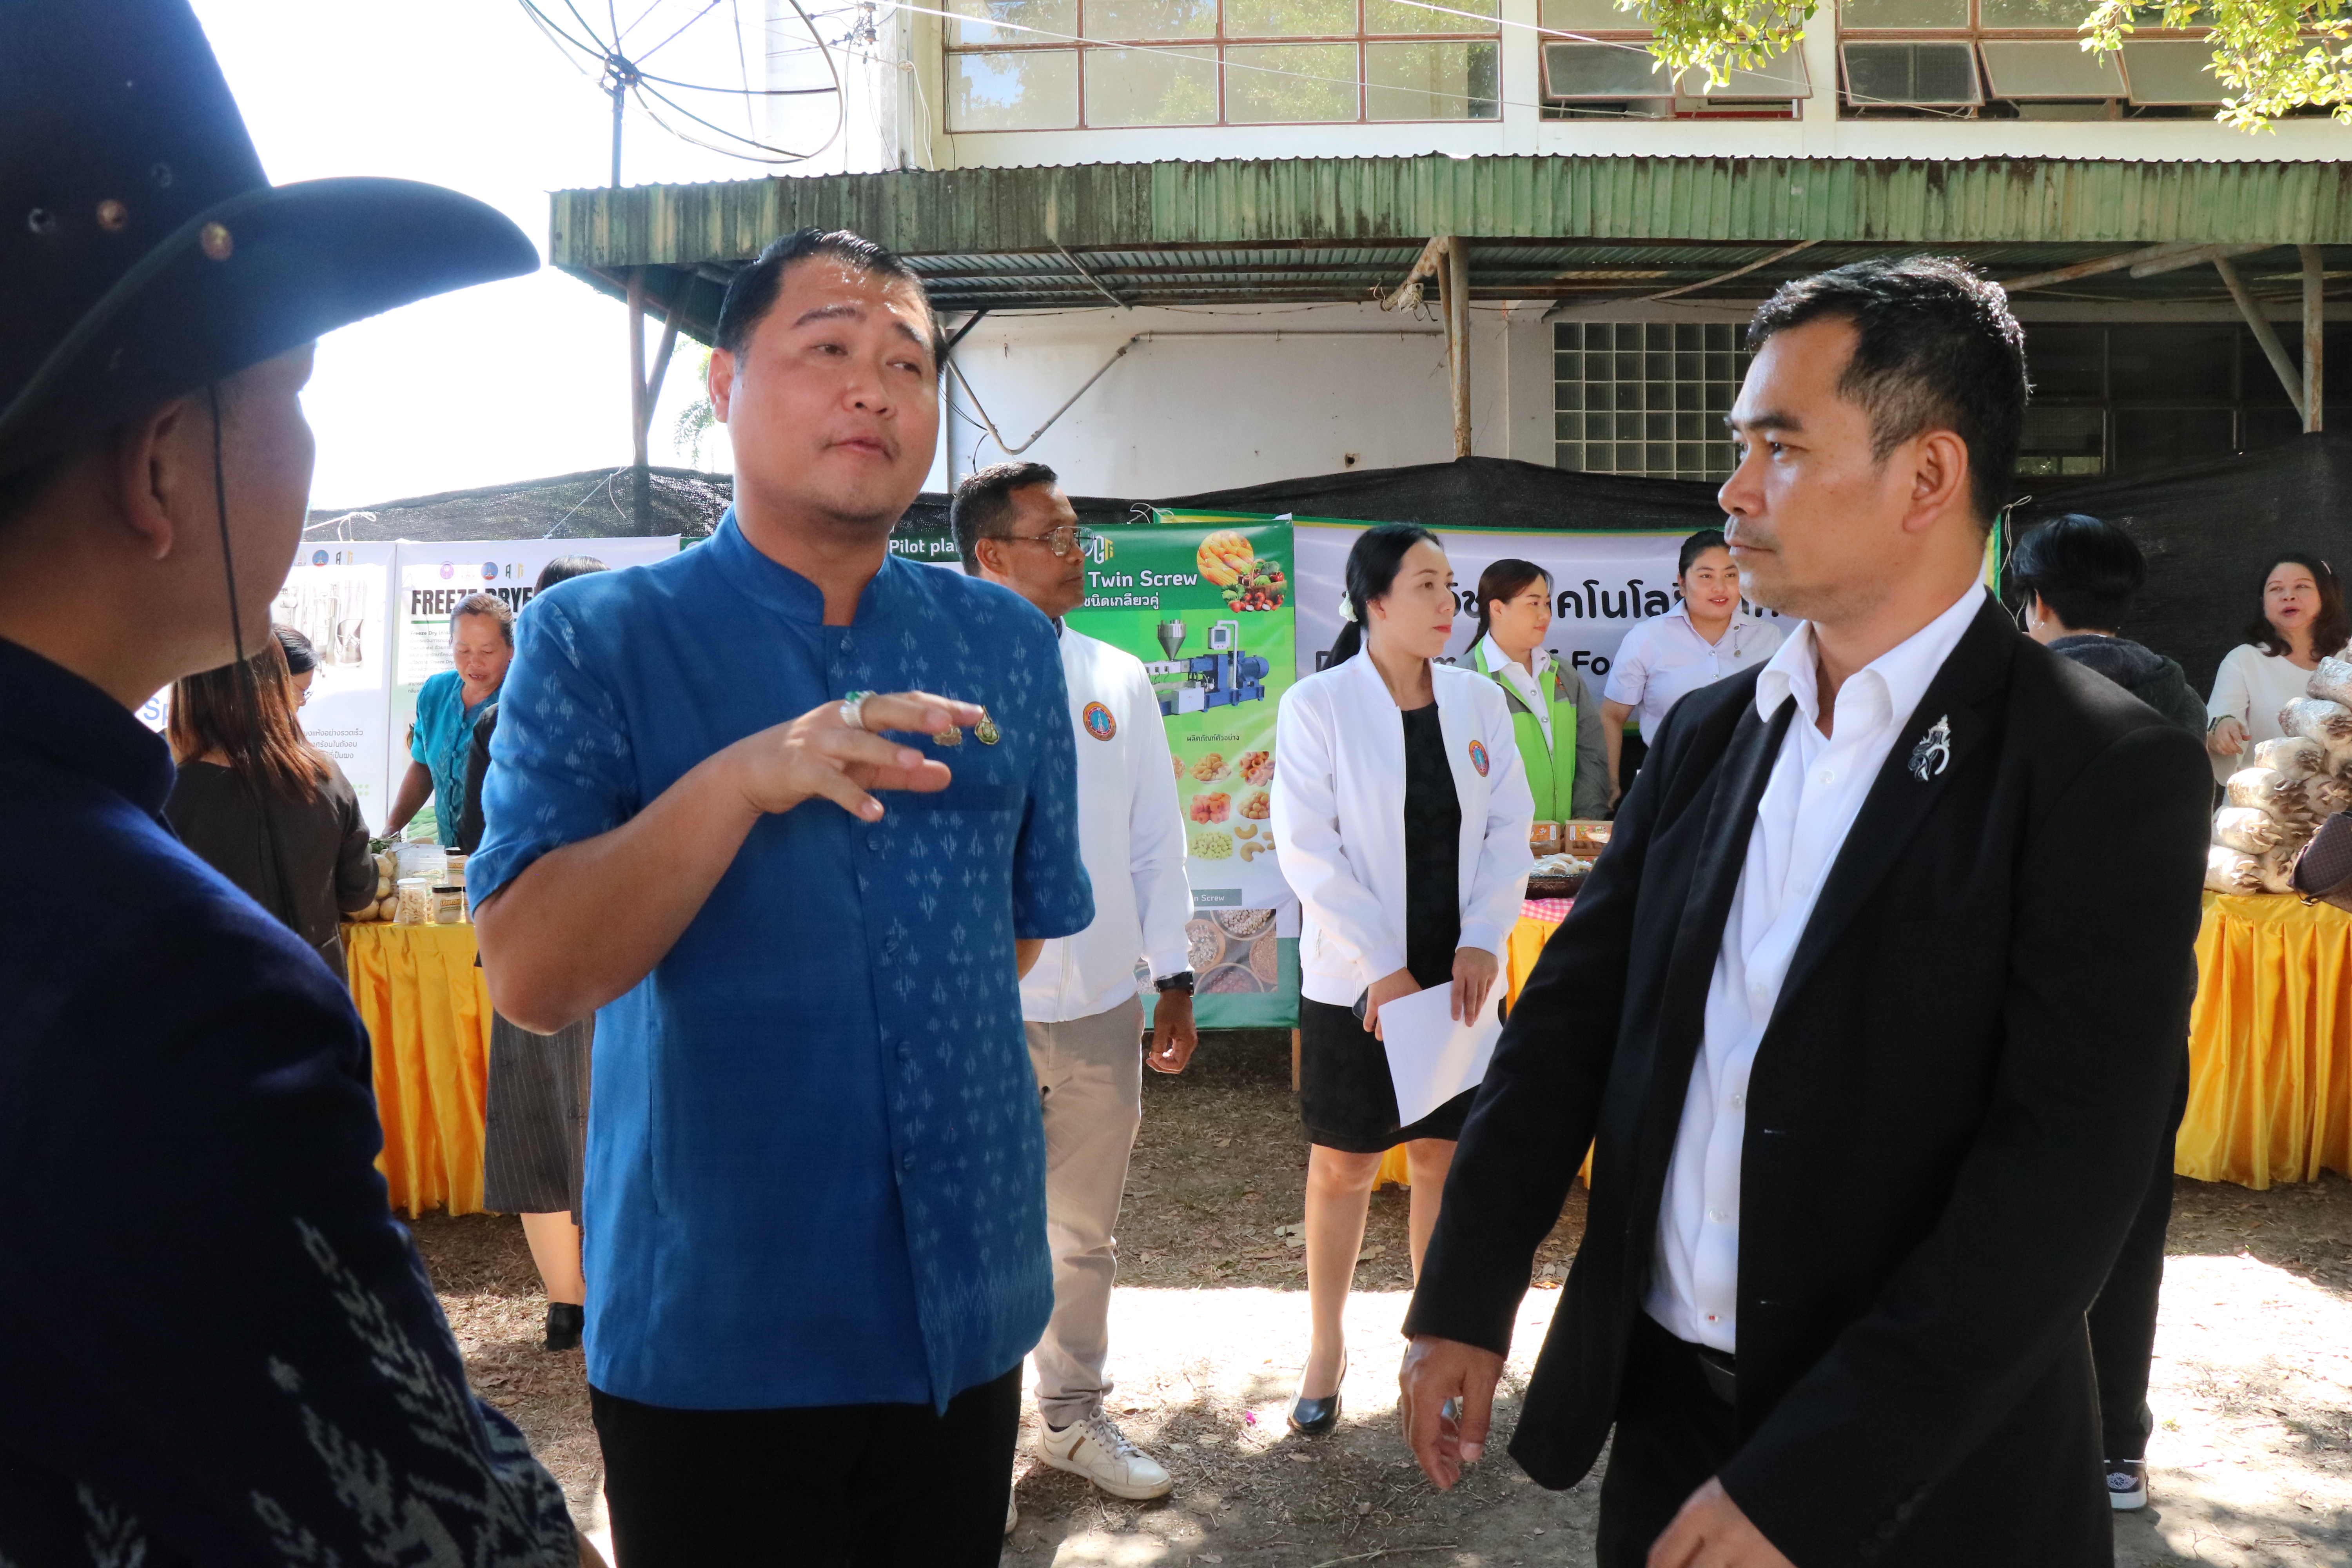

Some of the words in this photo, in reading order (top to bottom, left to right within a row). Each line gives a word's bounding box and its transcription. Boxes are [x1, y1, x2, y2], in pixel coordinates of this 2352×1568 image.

[889, 539, 925, 553] Pilot
[930, 537, 955, 556] pla
[1088, 571, 1133, 588] Twin
[1140, 570, 1198, 588] Screw
[1572, 650, 1613, 676] Fo
